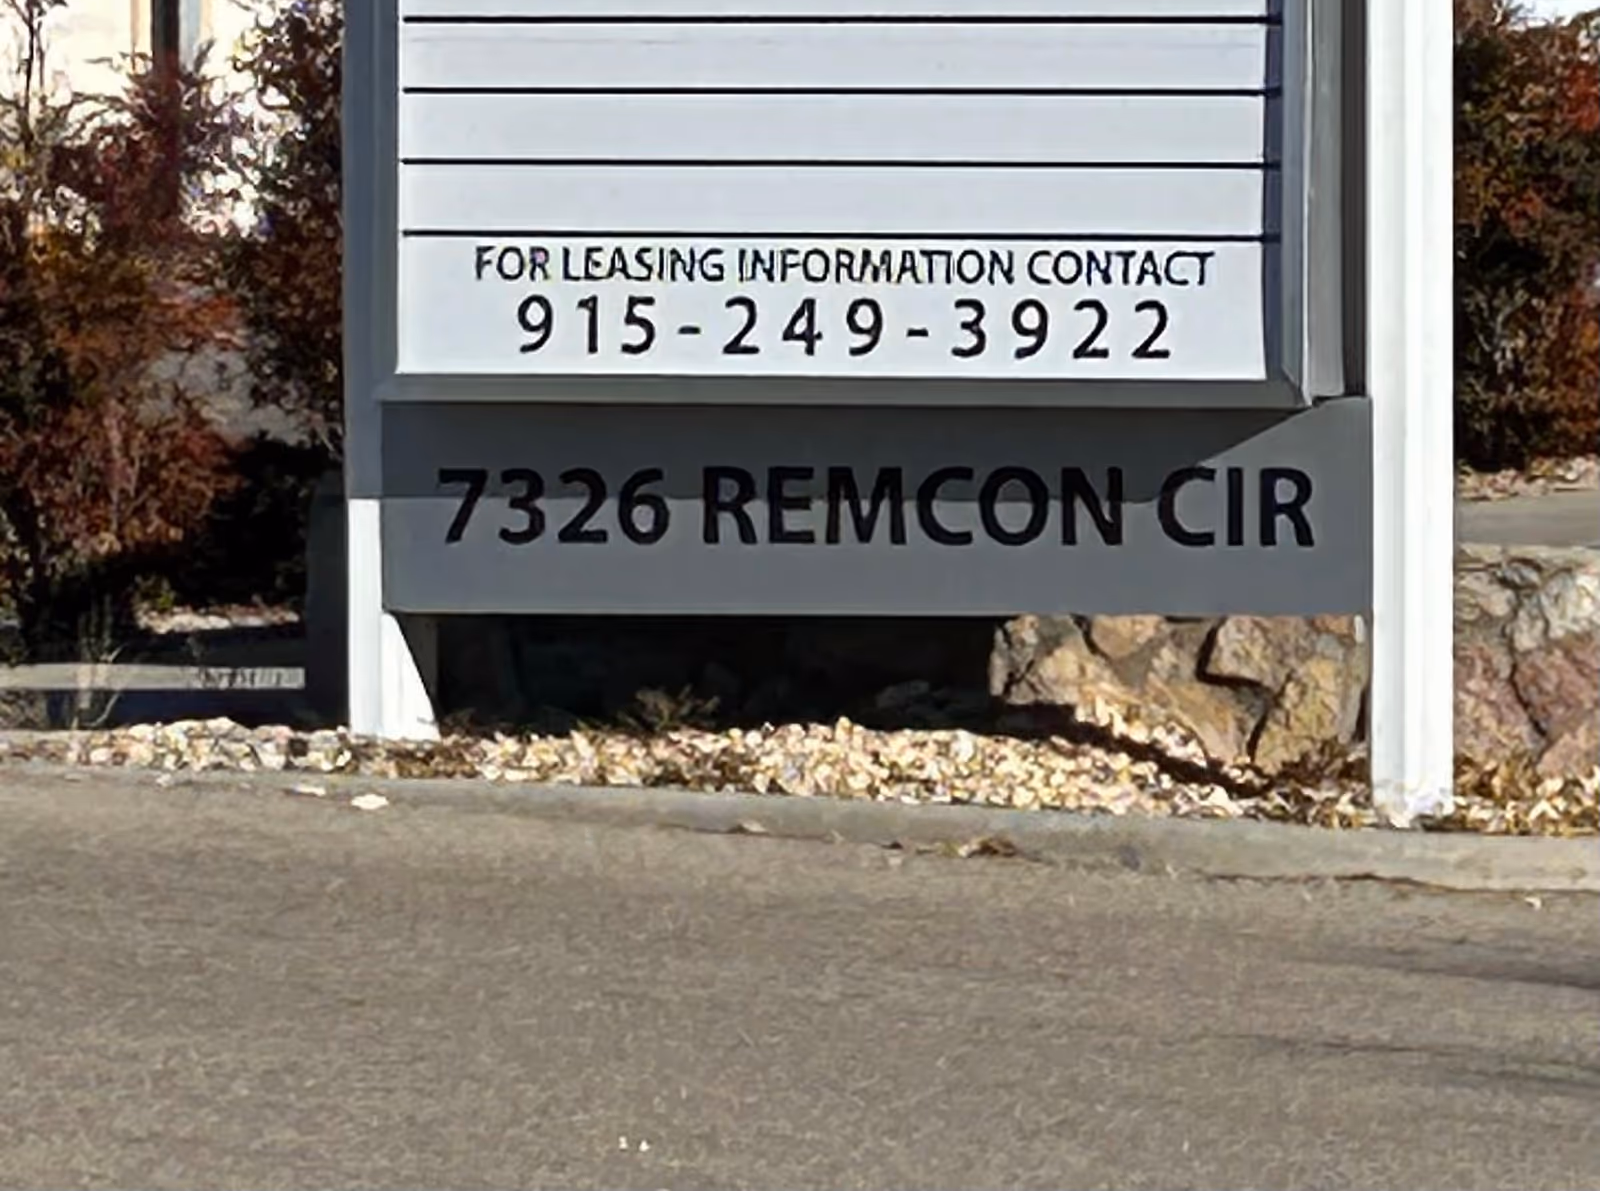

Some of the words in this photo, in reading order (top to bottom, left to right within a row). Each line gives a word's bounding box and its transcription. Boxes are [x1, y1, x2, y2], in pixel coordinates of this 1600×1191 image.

[475, 245, 550, 282] FOR
[562, 246, 725, 283] LEASING
[738, 247, 1015, 286] INFORMATION
[1027, 249, 1214, 287] CONTACT
[517, 294, 1172, 360] 915-249-3922
[437, 466, 671, 545] 7326
[702, 466, 1123, 546] REMCON
[1157, 466, 1315, 548] CIR
